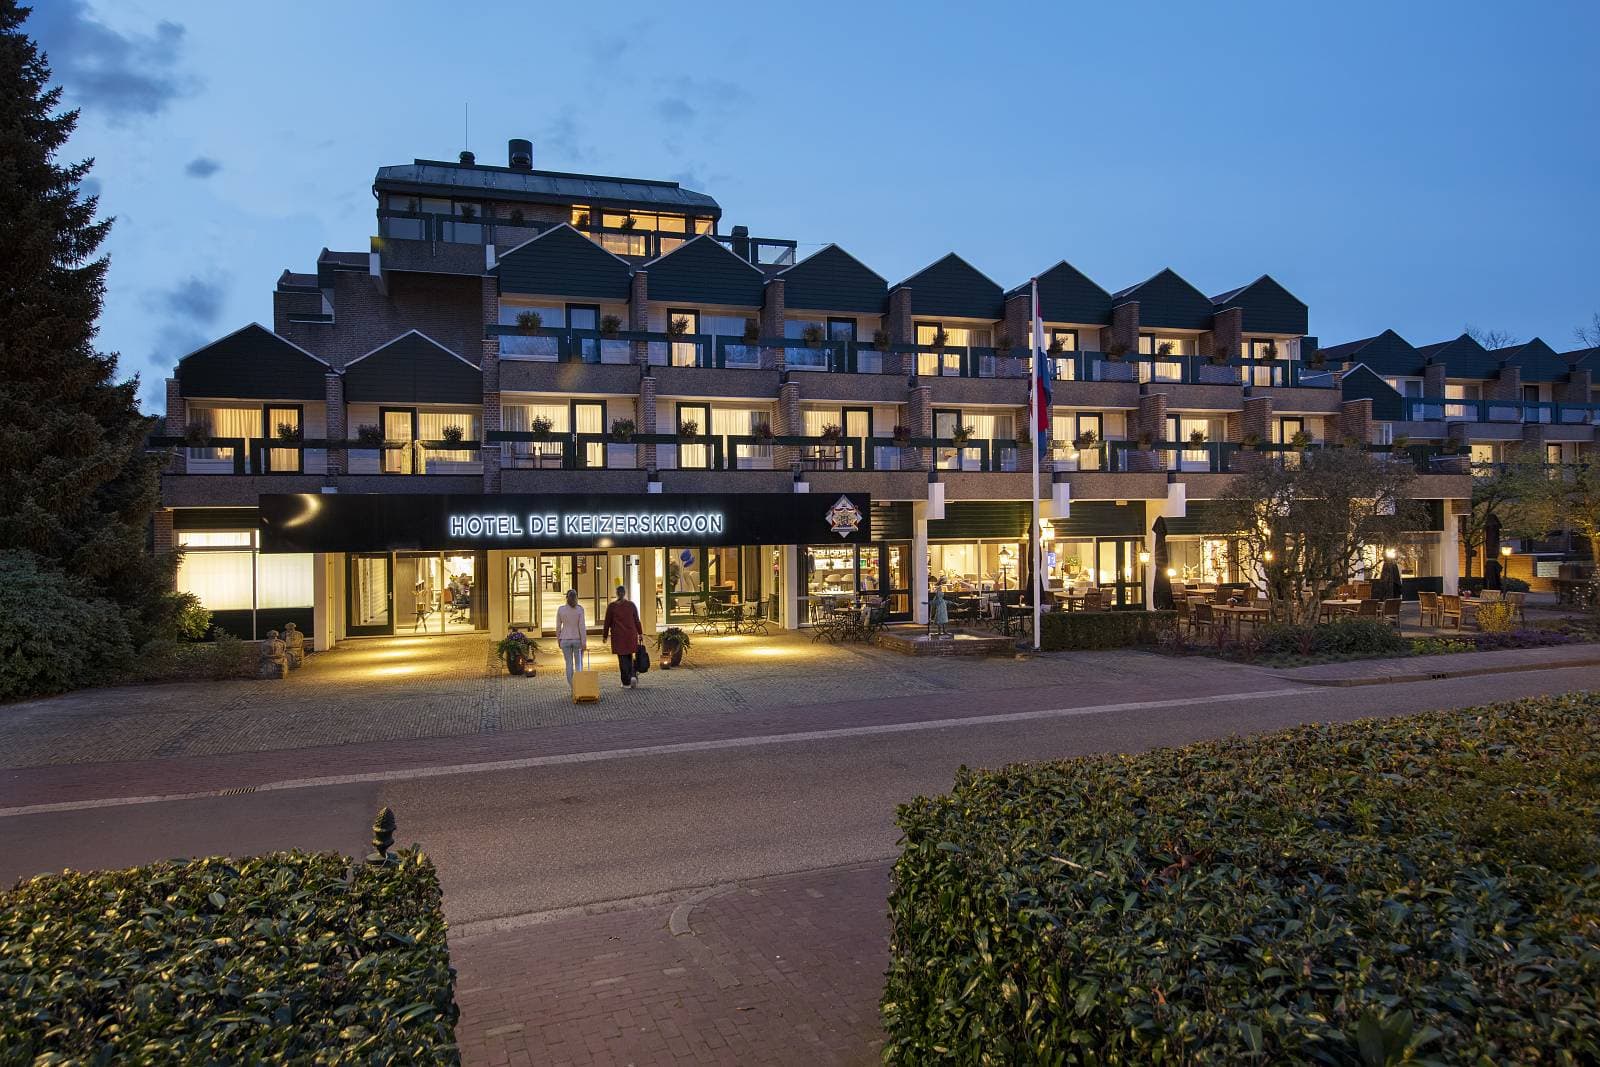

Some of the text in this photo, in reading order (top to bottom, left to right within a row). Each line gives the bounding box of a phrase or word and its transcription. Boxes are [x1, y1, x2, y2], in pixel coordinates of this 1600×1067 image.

[451, 514, 723, 535] HOTEL DE KEIZERSKROON
